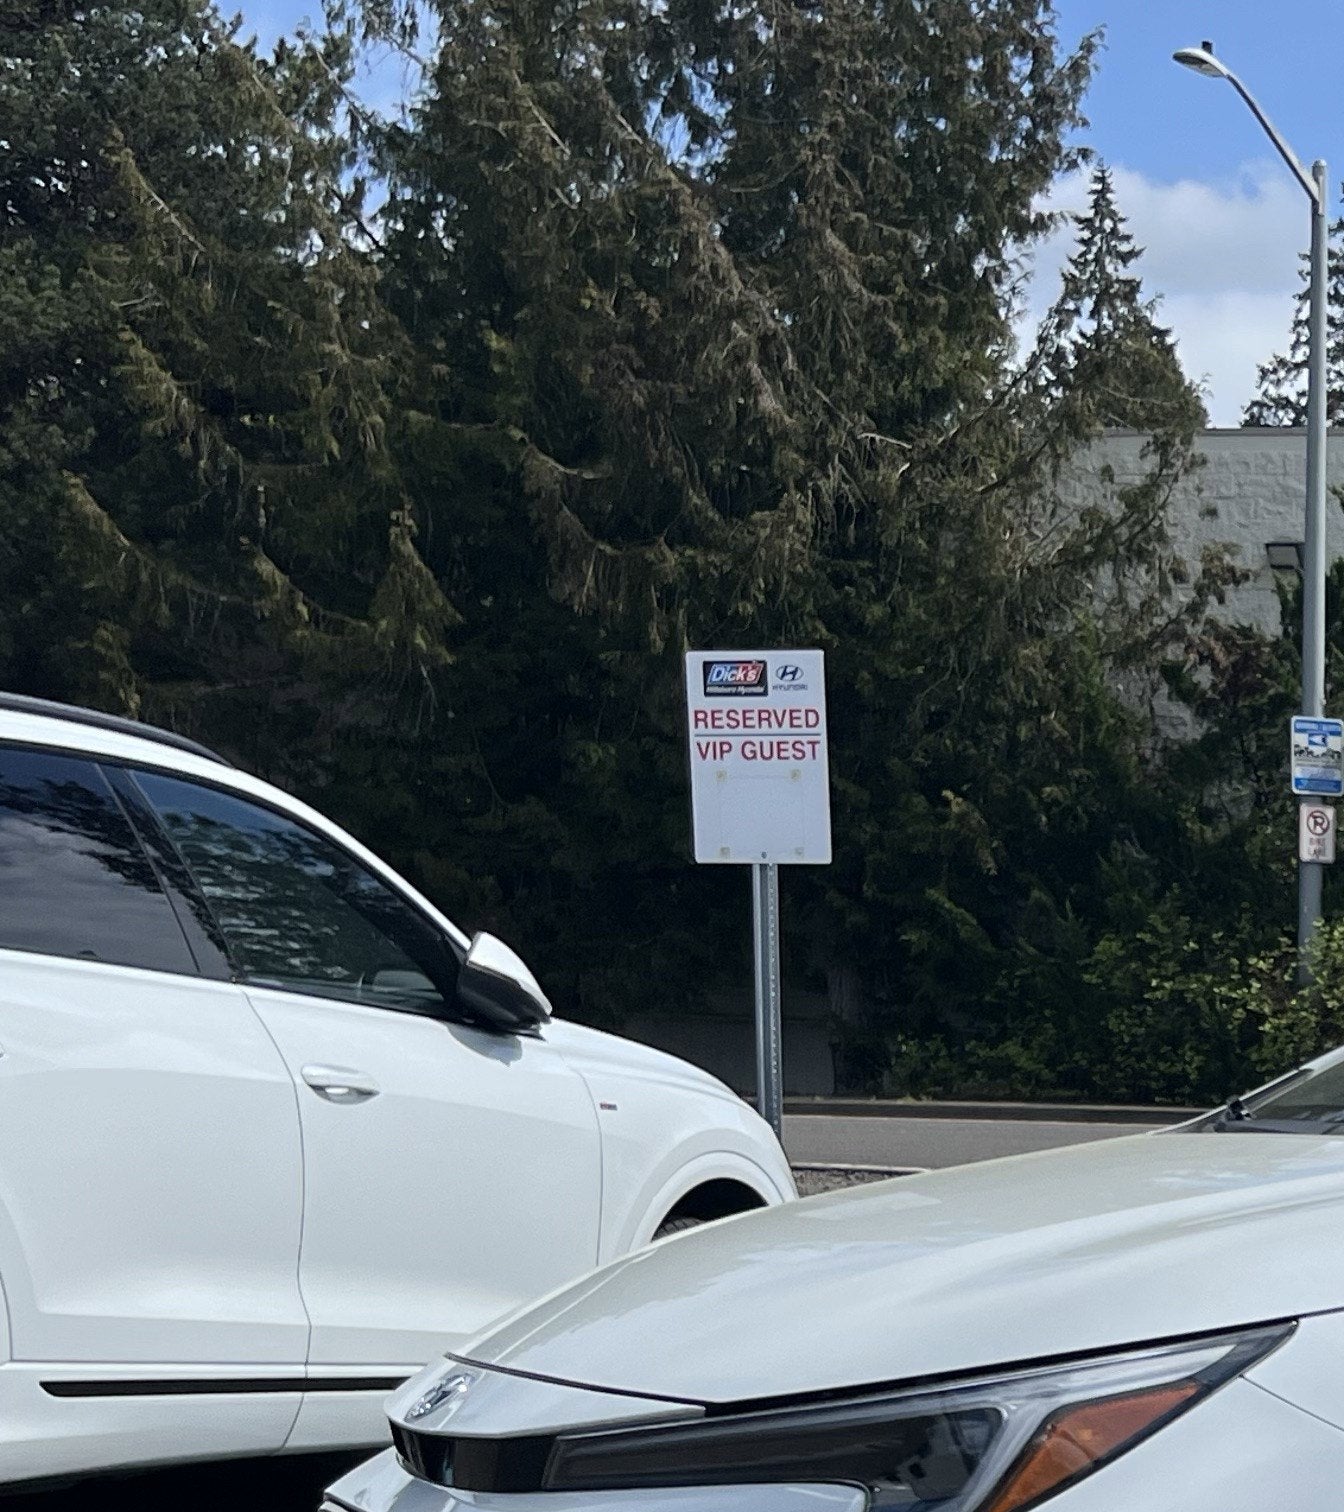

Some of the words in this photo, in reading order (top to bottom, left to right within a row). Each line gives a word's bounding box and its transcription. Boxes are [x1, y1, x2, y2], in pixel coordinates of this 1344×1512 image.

[694, 708, 820, 730] RESERVED
[696, 740, 732, 761] VIP
[741, 740, 821, 761] GUEST
